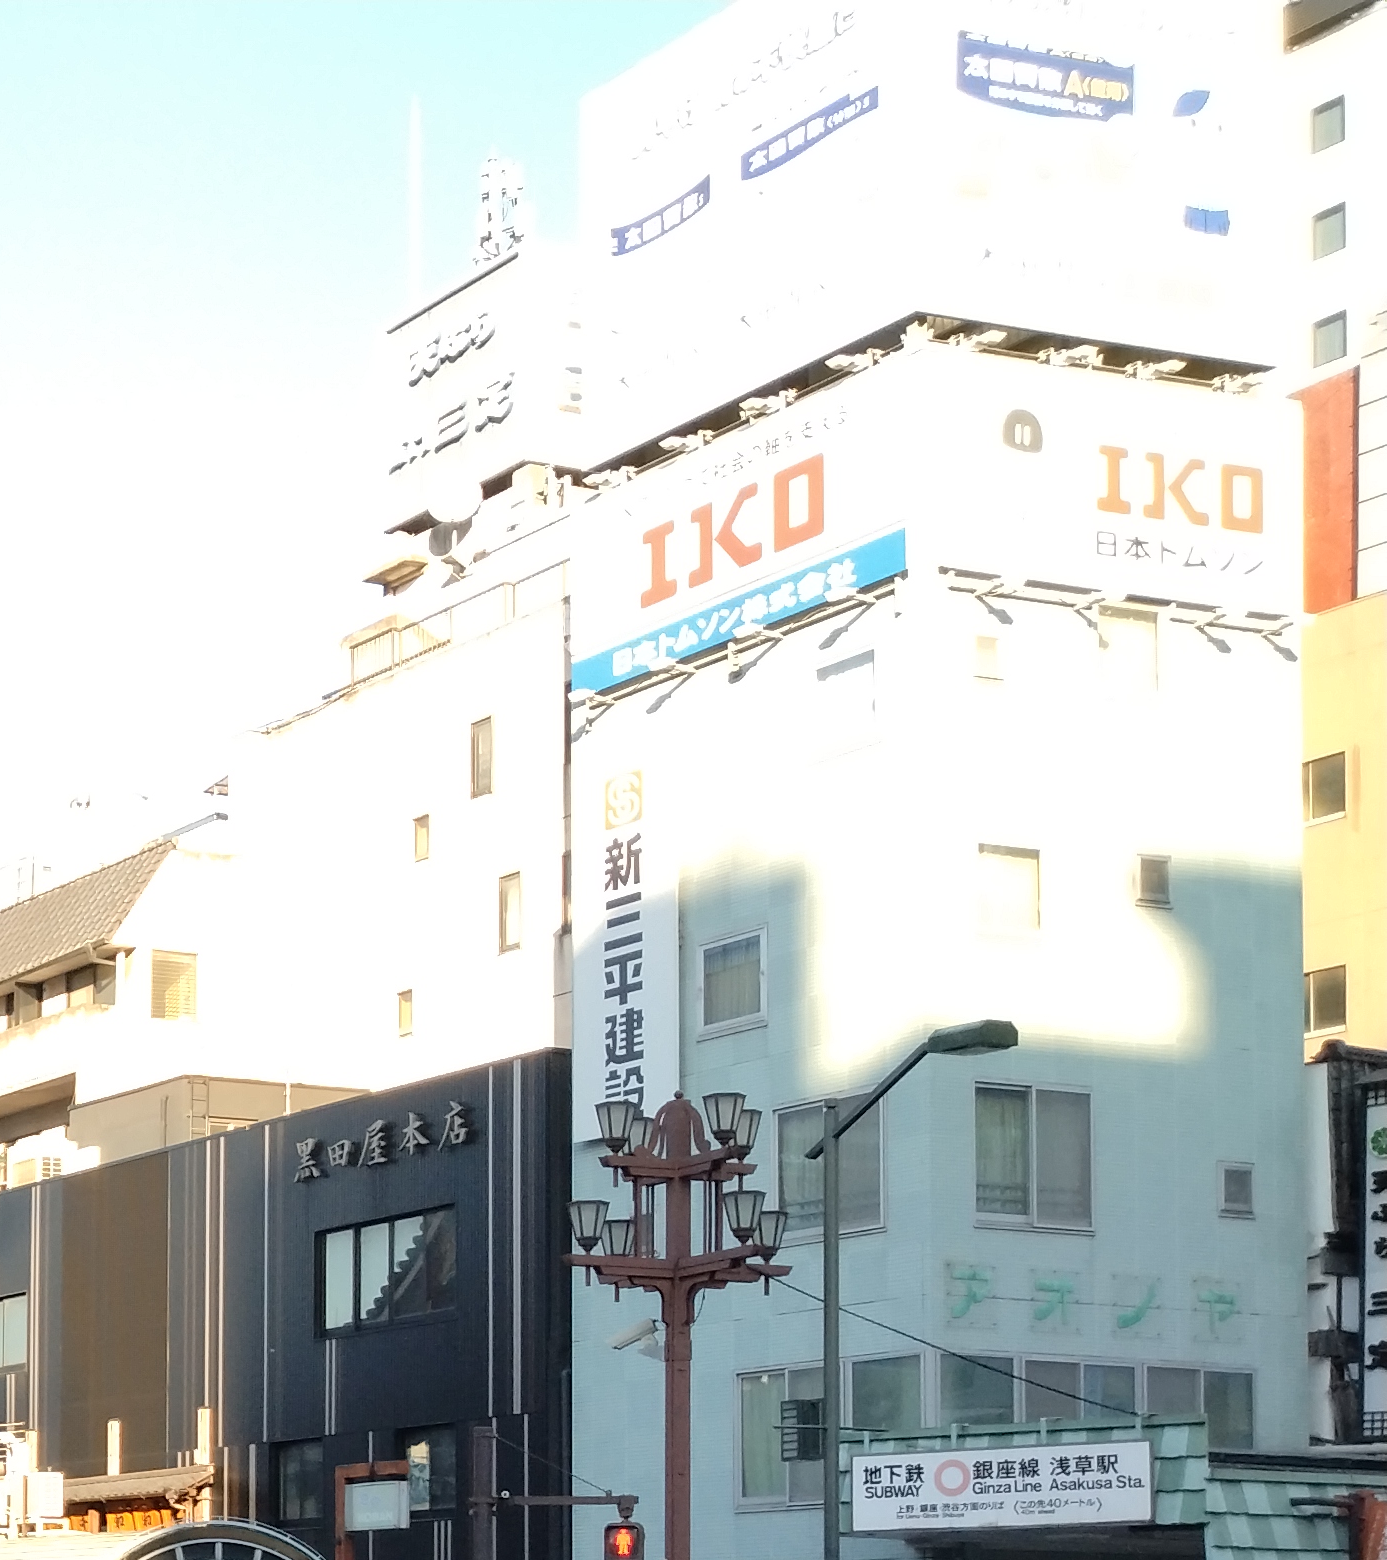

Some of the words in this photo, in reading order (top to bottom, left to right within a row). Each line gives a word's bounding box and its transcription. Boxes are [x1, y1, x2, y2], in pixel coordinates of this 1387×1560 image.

[640, 453, 825, 609] IKO
[1096, 444, 1264, 534] IKO
[603, 833, 645, 1118] 新三平建設
[293, 1100, 470, 1184] 黒田屋本店
[950, 1267, 1237, 1334] アオノヤ
[862, 1464, 925, 1485] 地下鉄
[972, 1458, 1041, 1480] 銀座線
[1049, 1454, 1119, 1476] 浅草駅
[864, 1484, 924, 1499] SUBWAY
[972, 1480, 1012, 1496] Ginza
[1014, 1479, 1042, 1493] Line
[1049, 1477, 1113, 1492] Asakusa
[1116, 1475, 1145, 1490] Sta.
